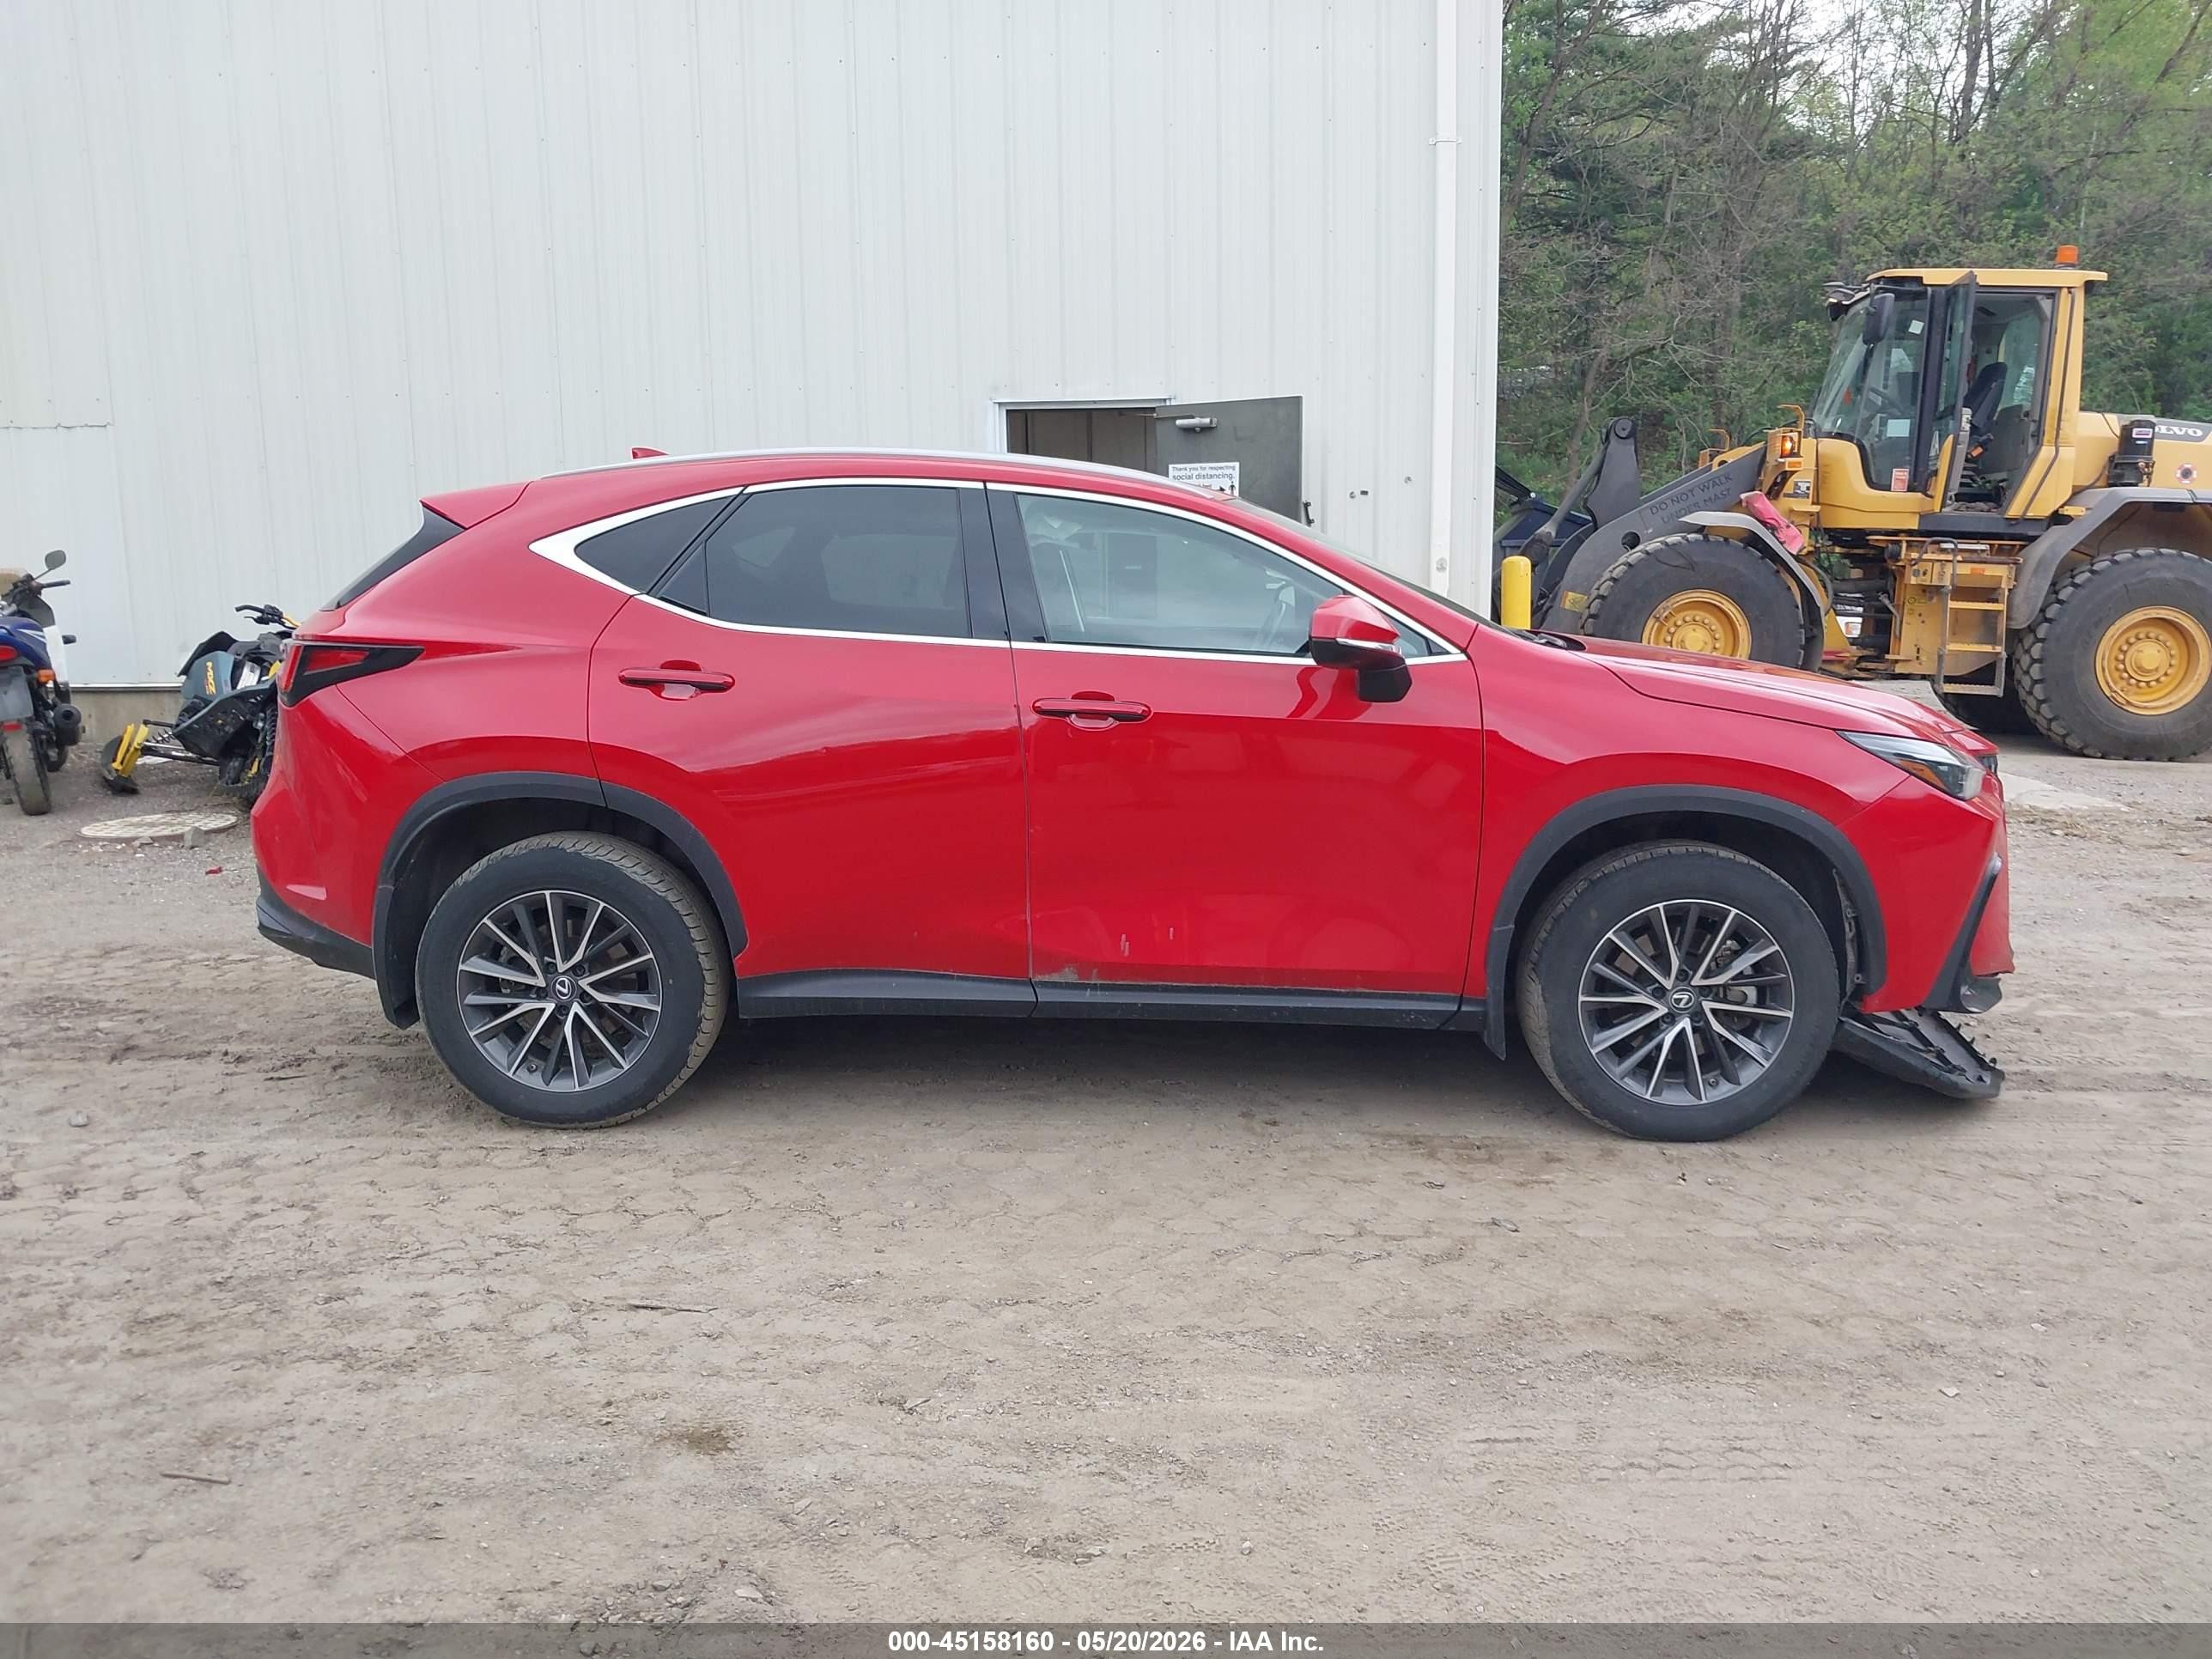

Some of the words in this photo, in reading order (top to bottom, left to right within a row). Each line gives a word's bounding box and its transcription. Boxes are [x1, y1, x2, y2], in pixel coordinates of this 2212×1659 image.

[2155, 425, 2203, 436] LVO
[1650, 501, 1668, 515] DO
[1670, 489, 1697, 507] NOT
[1699, 473, 1733, 493] WALK
[1661, 501, 1700, 524] UNDER
[1704, 488, 1731, 507] MAST
